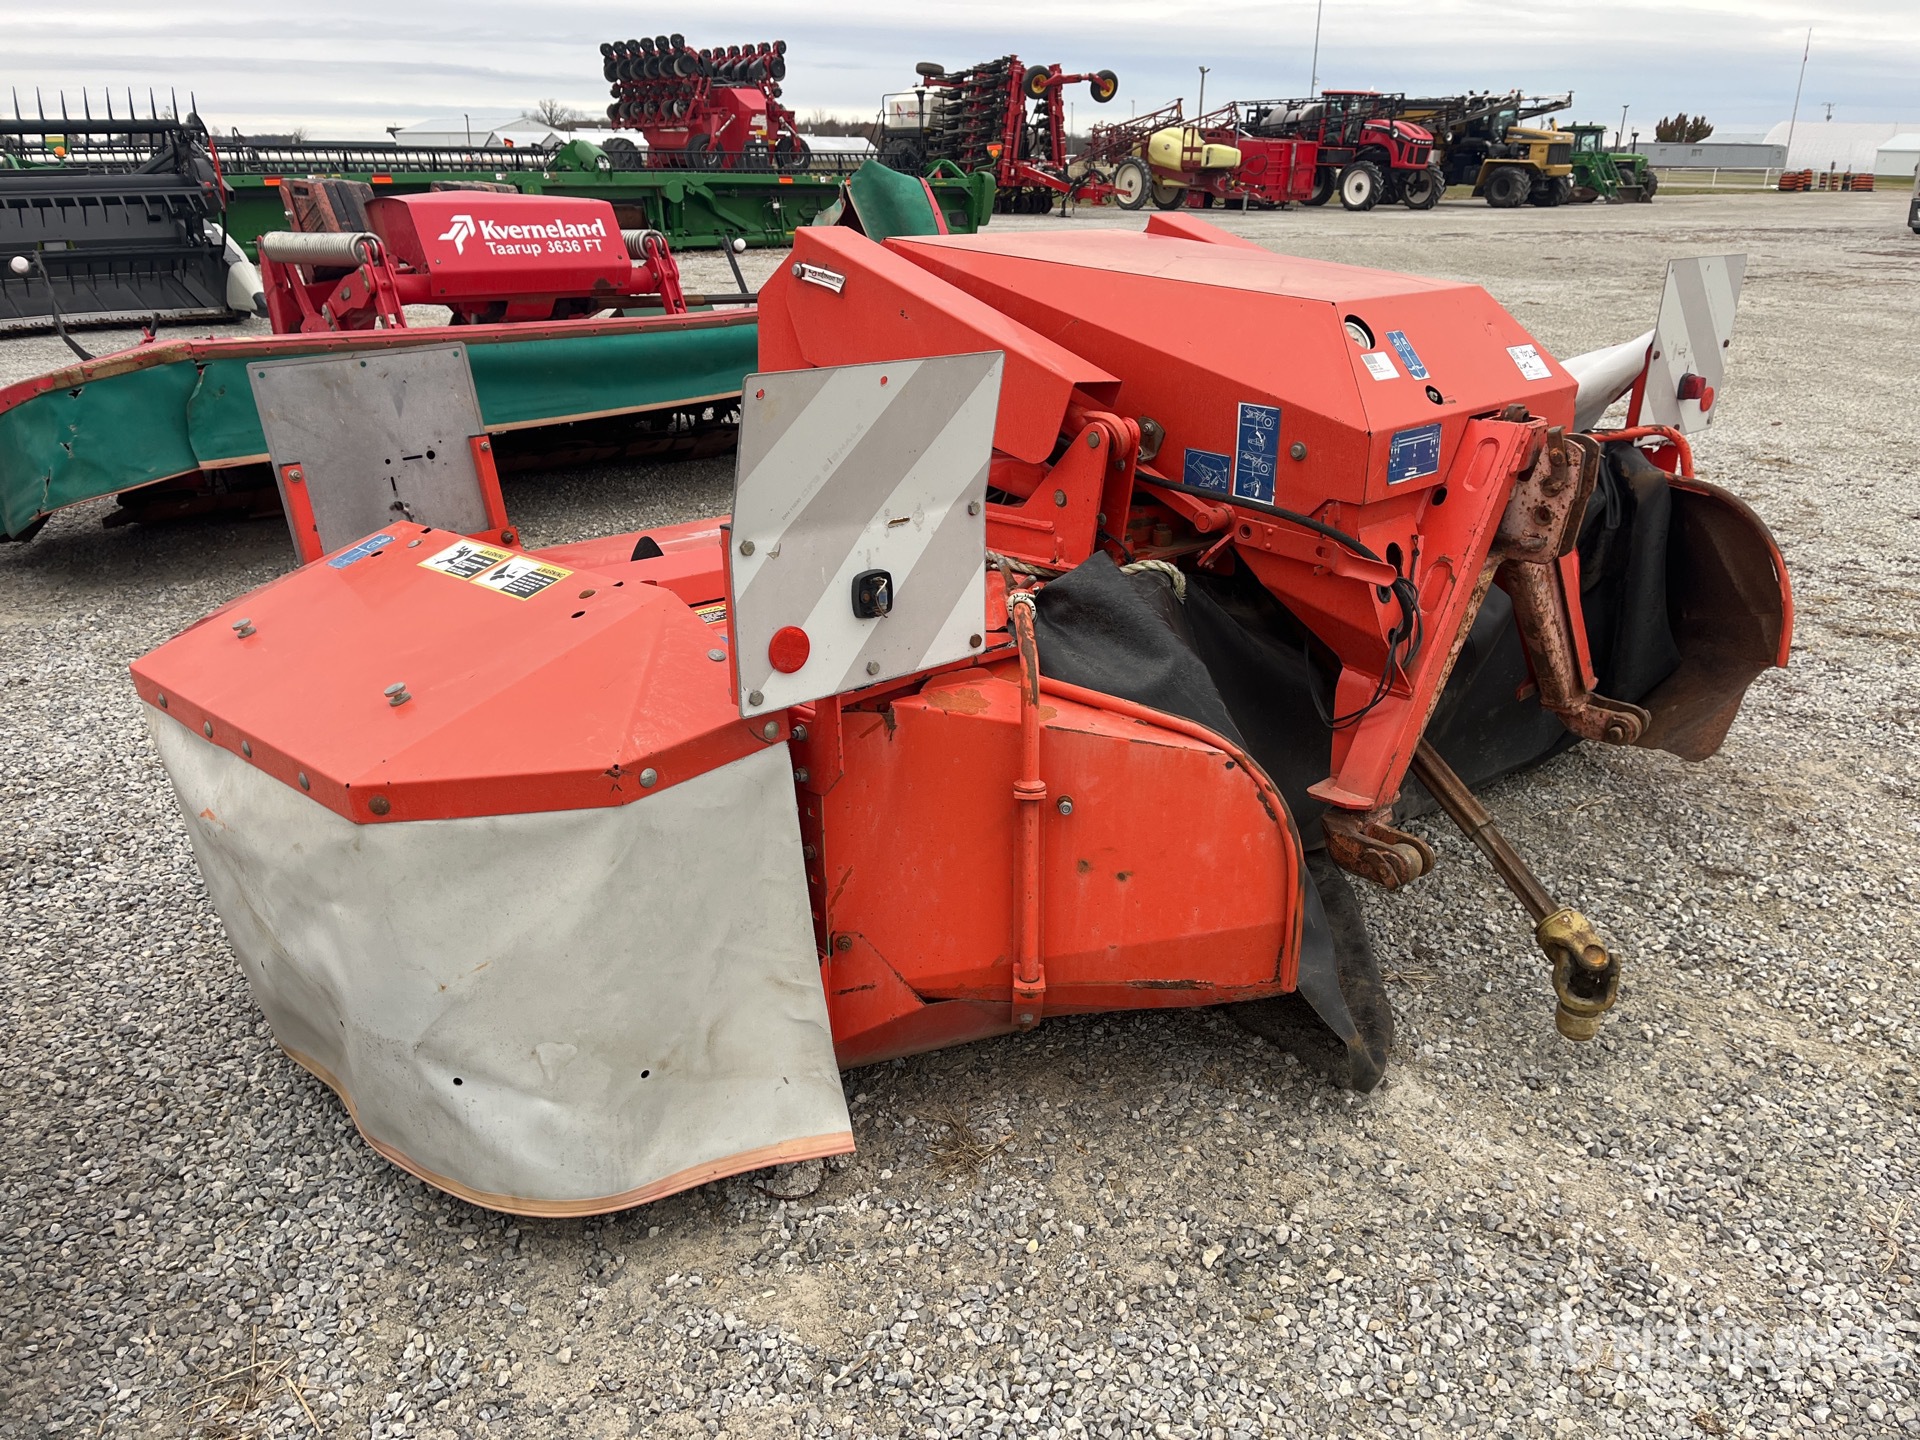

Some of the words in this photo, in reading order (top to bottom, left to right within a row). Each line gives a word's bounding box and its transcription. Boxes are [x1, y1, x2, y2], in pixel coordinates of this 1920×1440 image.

[478, 218, 607, 240] Kverneland
[486, 241, 542, 257] Taarup
[546, 240, 581, 254] 3636
[584, 239, 602, 253] FT
